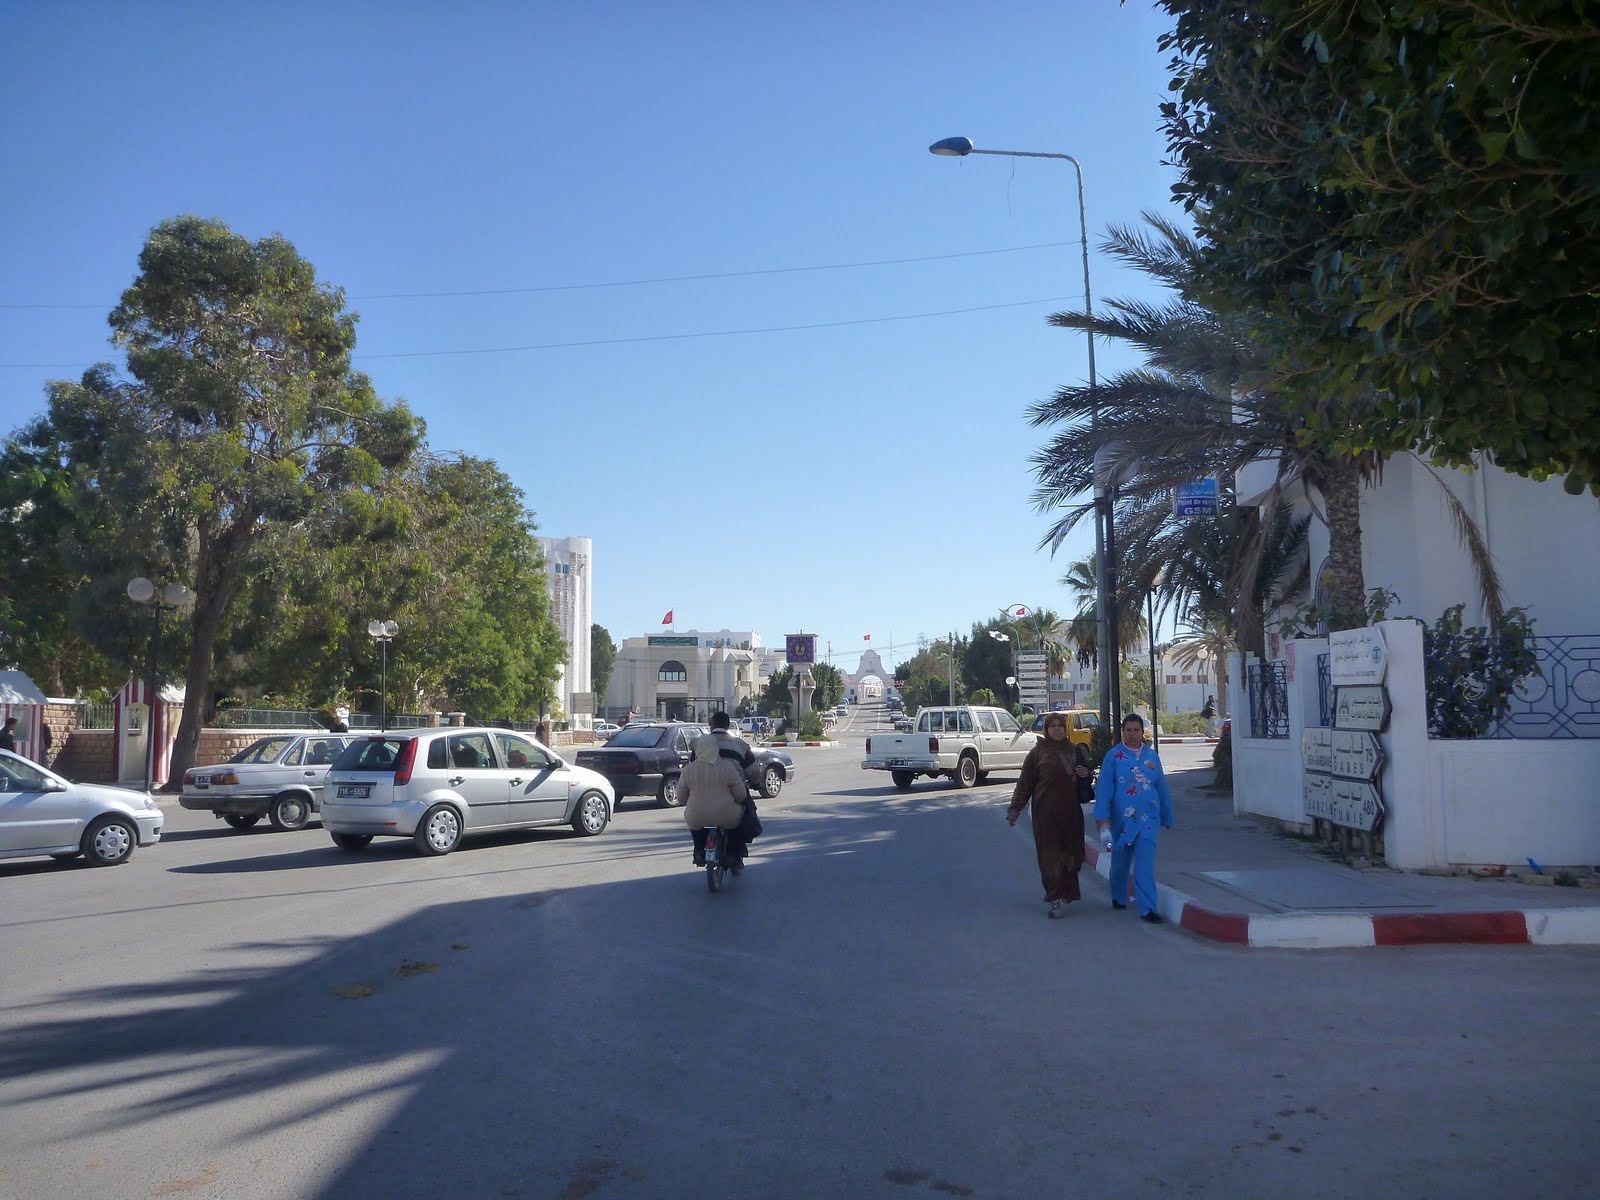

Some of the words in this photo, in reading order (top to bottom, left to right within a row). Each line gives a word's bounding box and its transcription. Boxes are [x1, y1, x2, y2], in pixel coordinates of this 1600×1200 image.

[1184, 507, 1211, 515] GSM
[1365, 748, 1374, 764] 75
[1333, 760, 1364, 775] GABES
[1333, 784, 1362, 808] تونس
[1308, 799, 1334, 815] ZARZIS
[1363, 799, 1375, 816] 480
[1333, 807, 1363, 826] TUNIS
